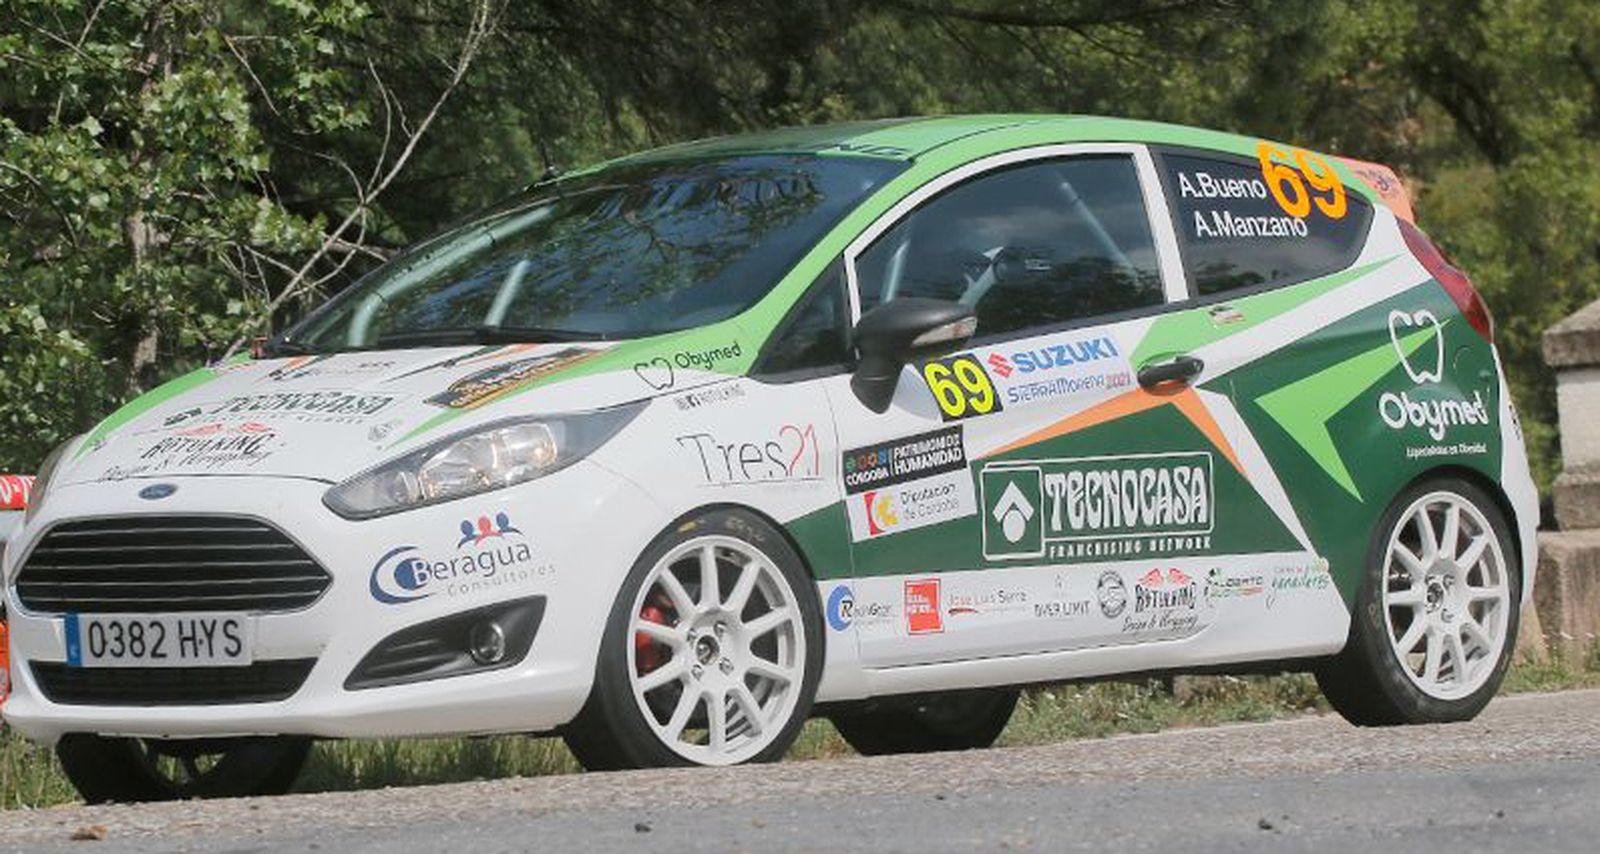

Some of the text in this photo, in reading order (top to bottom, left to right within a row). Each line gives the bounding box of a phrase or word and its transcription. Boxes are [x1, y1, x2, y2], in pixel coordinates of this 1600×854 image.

[1177, 171, 1267, 200] A.Bueno
[1256, 139, 1347, 219] 69
[1193, 210, 1309, 237] A.Manzano
[674, 341, 742, 368] Obymed
[1010, 337, 1119, 374] SUZUKI
[924, 357, 994, 418] 69
[1379, 390, 1489, 441] Obymed
[894, 447, 963, 476] HUMANIDAD
[1044, 466, 1208, 531] TECNOCASA
[1149, 536, 1212, 552] NETWORK
[411, 542, 532, 586] Beragua
[447, 562, 556, 597] Consultores
[88, 619, 243, 659] 0382 HYS
